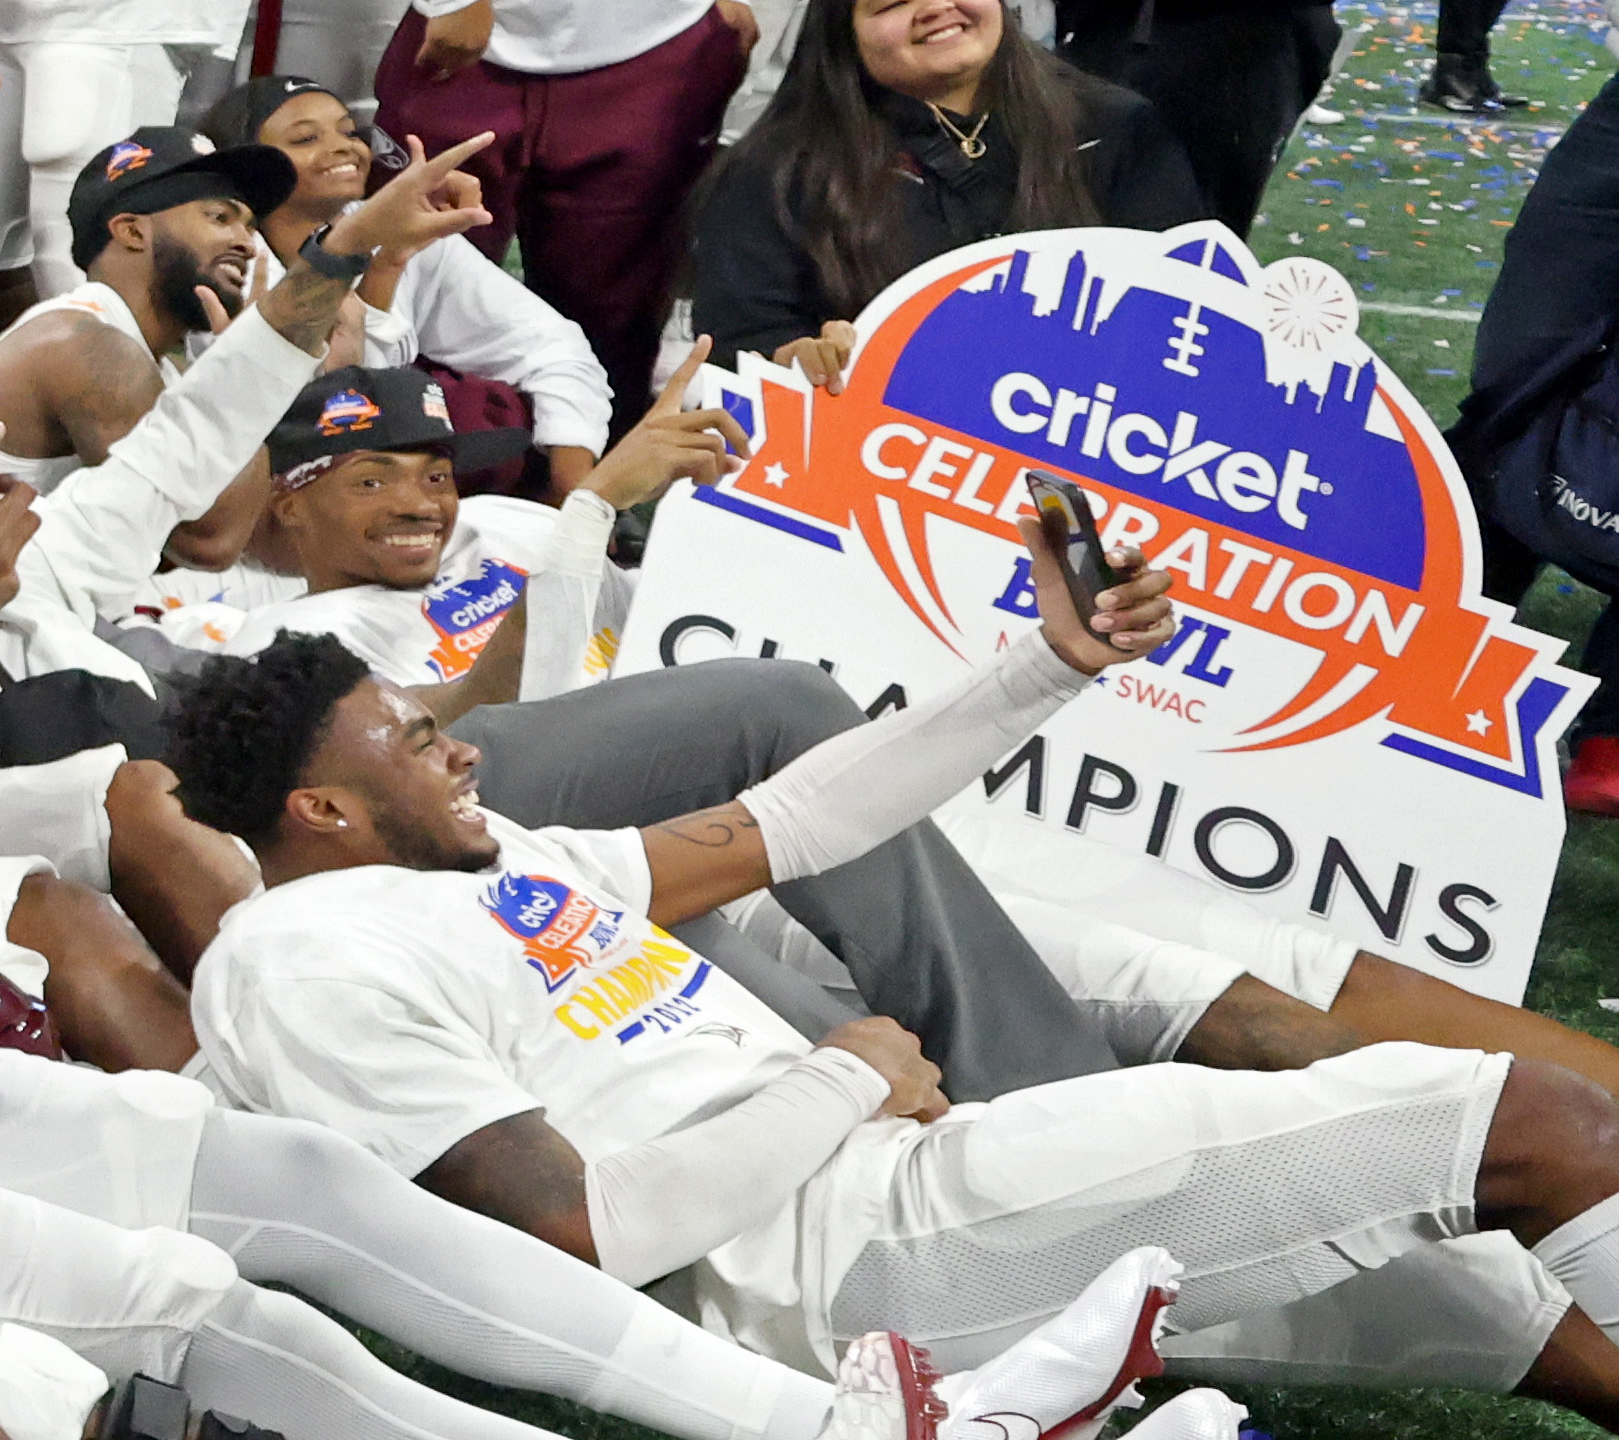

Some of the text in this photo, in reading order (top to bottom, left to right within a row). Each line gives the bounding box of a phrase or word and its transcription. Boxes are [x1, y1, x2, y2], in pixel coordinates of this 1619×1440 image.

[989, 372, 1314, 531] cricket
[450, 576, 519, 628] cricket
[1116, 672, 1206, 725] SWAC
